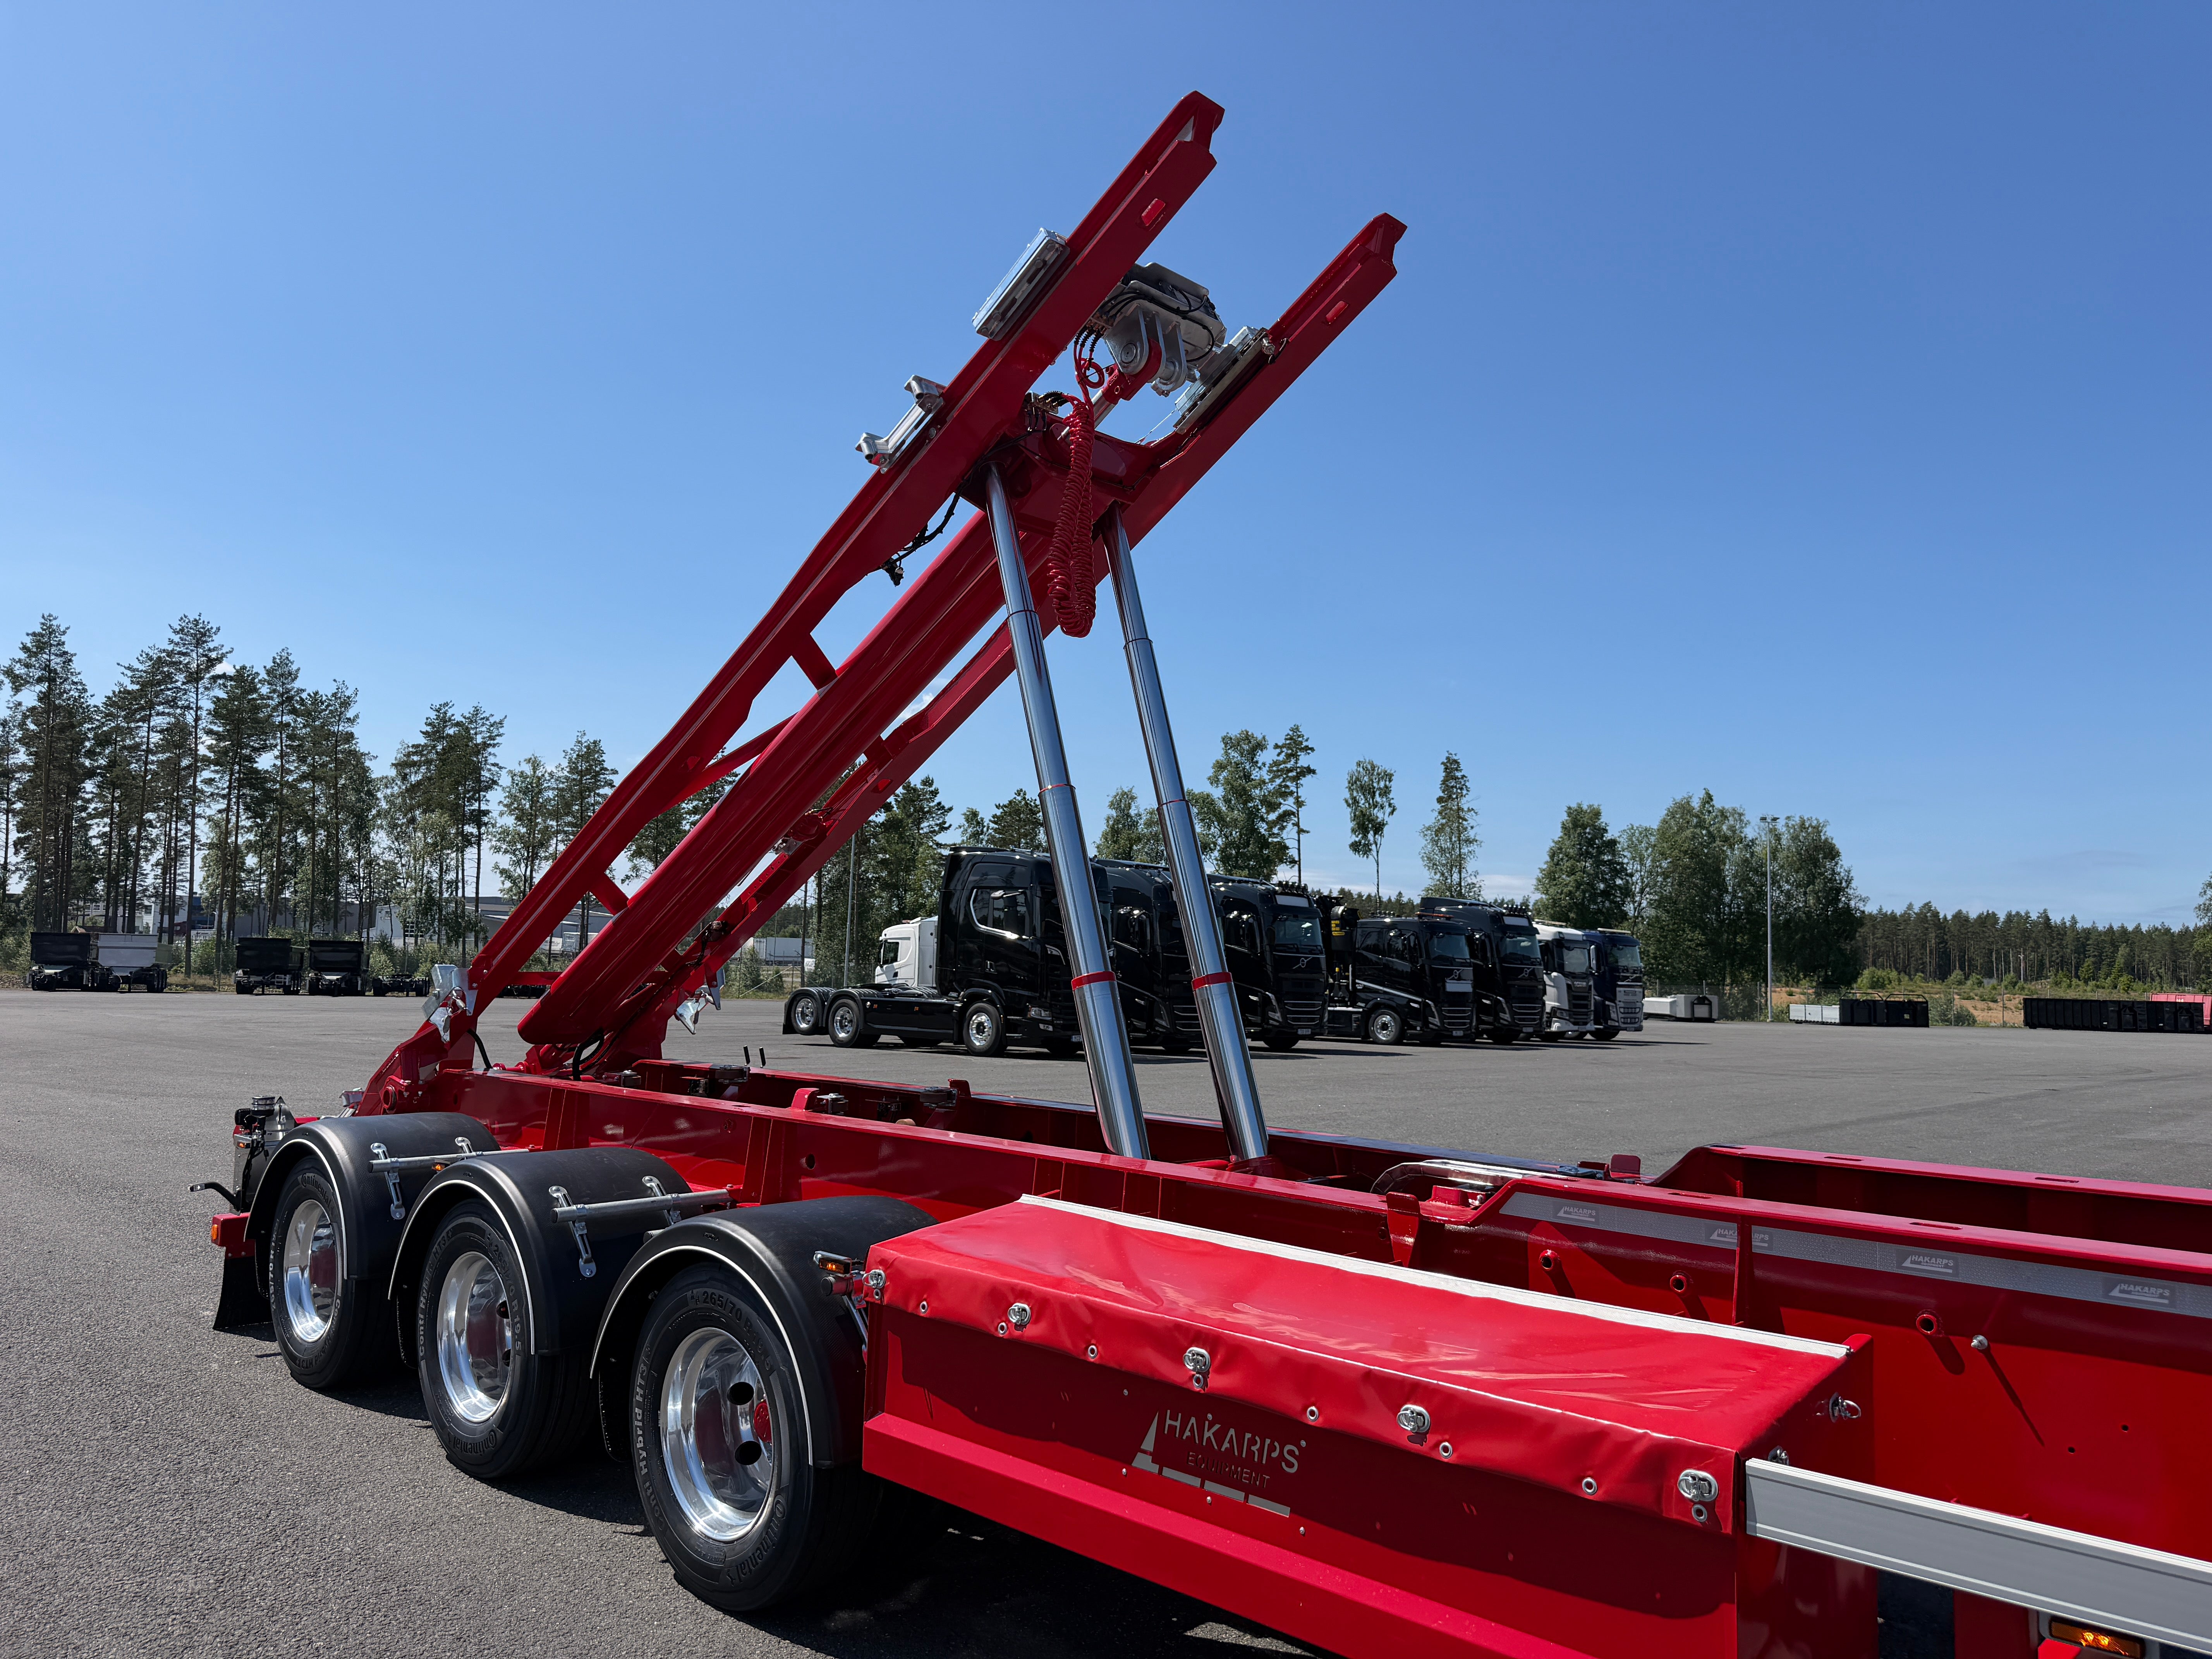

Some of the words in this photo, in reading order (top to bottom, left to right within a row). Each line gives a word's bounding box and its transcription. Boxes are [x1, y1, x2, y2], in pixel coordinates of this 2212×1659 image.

[301, 1173, 331, 1208] Continental
[1565, 1206, 1596, 1216] HAKARPS
[1911, 1255, 1954, 1266] HAKARPS
[702, 1290, 742, 1323] 265/70
[2120, 1283, 2170, 1296] HAKARPS
[635, 1362, 647, 1403] HT3
[453, 1429, 497, 1456] Continental
[635, 1408, 648, 1476] Hybrid
[1164, 1410, 1300, 1474] HAKARPS
[1187, 1452, 1271, 1489] EQUIPMENT
[644, 1480, 665, 1531] Conti
